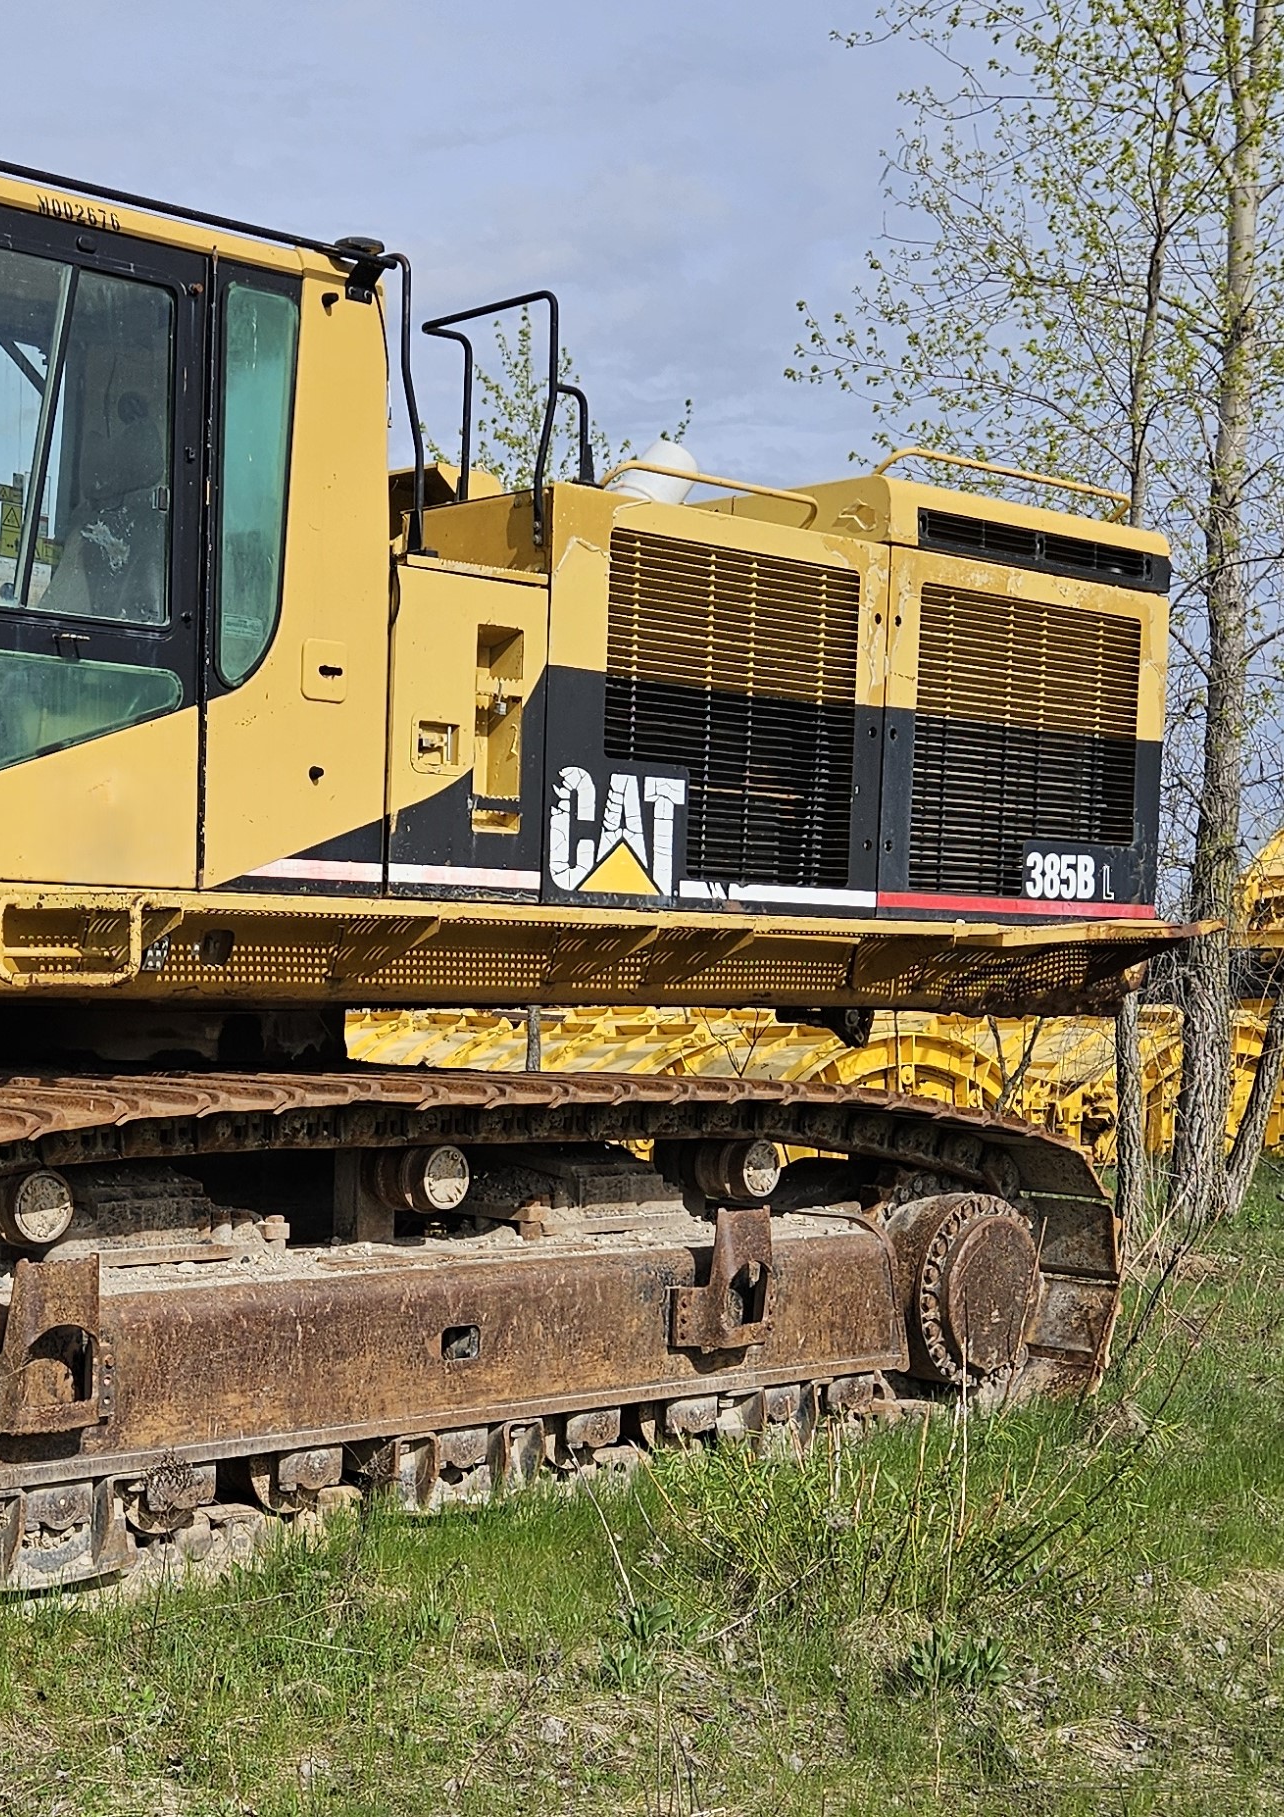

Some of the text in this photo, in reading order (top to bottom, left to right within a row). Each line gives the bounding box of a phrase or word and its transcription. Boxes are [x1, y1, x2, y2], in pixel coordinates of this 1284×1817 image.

[549, 766, 686, 897] CAT
[1025, 851, 1115, 900] 385B L
